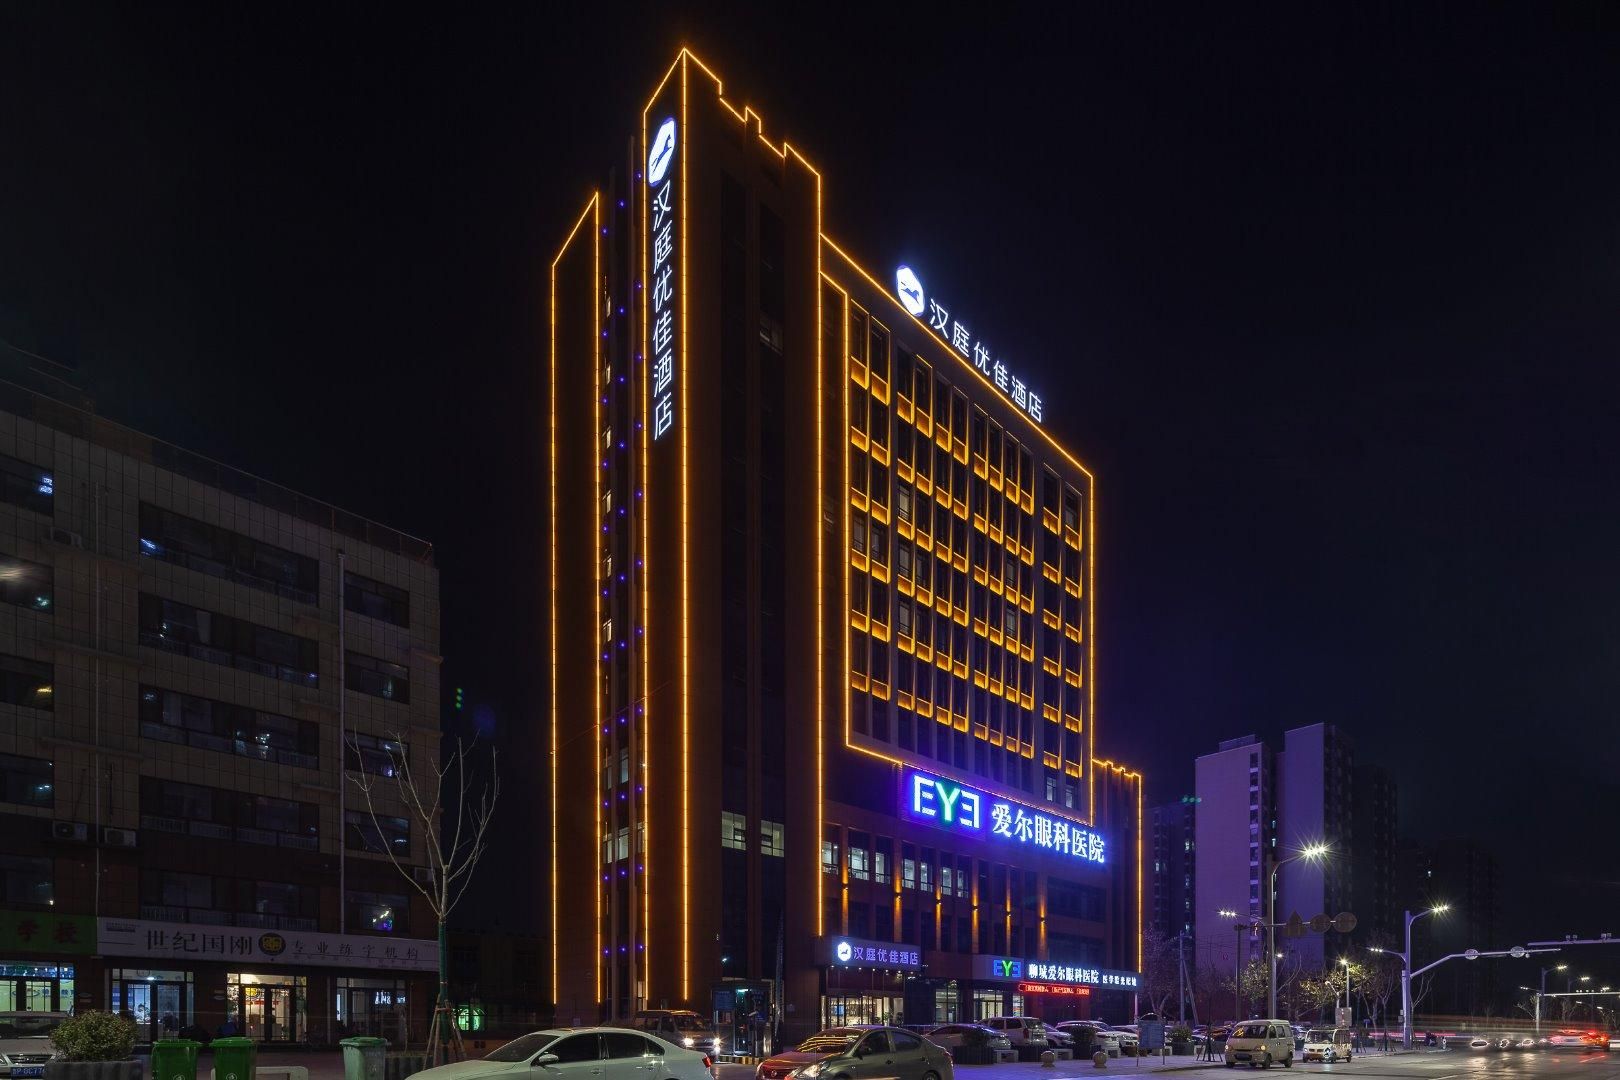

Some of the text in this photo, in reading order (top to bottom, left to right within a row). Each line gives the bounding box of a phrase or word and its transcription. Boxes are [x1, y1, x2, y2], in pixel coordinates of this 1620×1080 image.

[652, 179, 673, 441] 汉庭优佳酒店
[929, 298, 1042, 424] 汉庭优佳酒店
[991, 803, 1105, 863] 爱尔眼科医院
[145, 930, 253, 956] 世纪国刚
[853, 945, 918, 965] 汉庭优佳酒店
[1028, 963, 1100, 983] 聊城爱尔眼科医院
